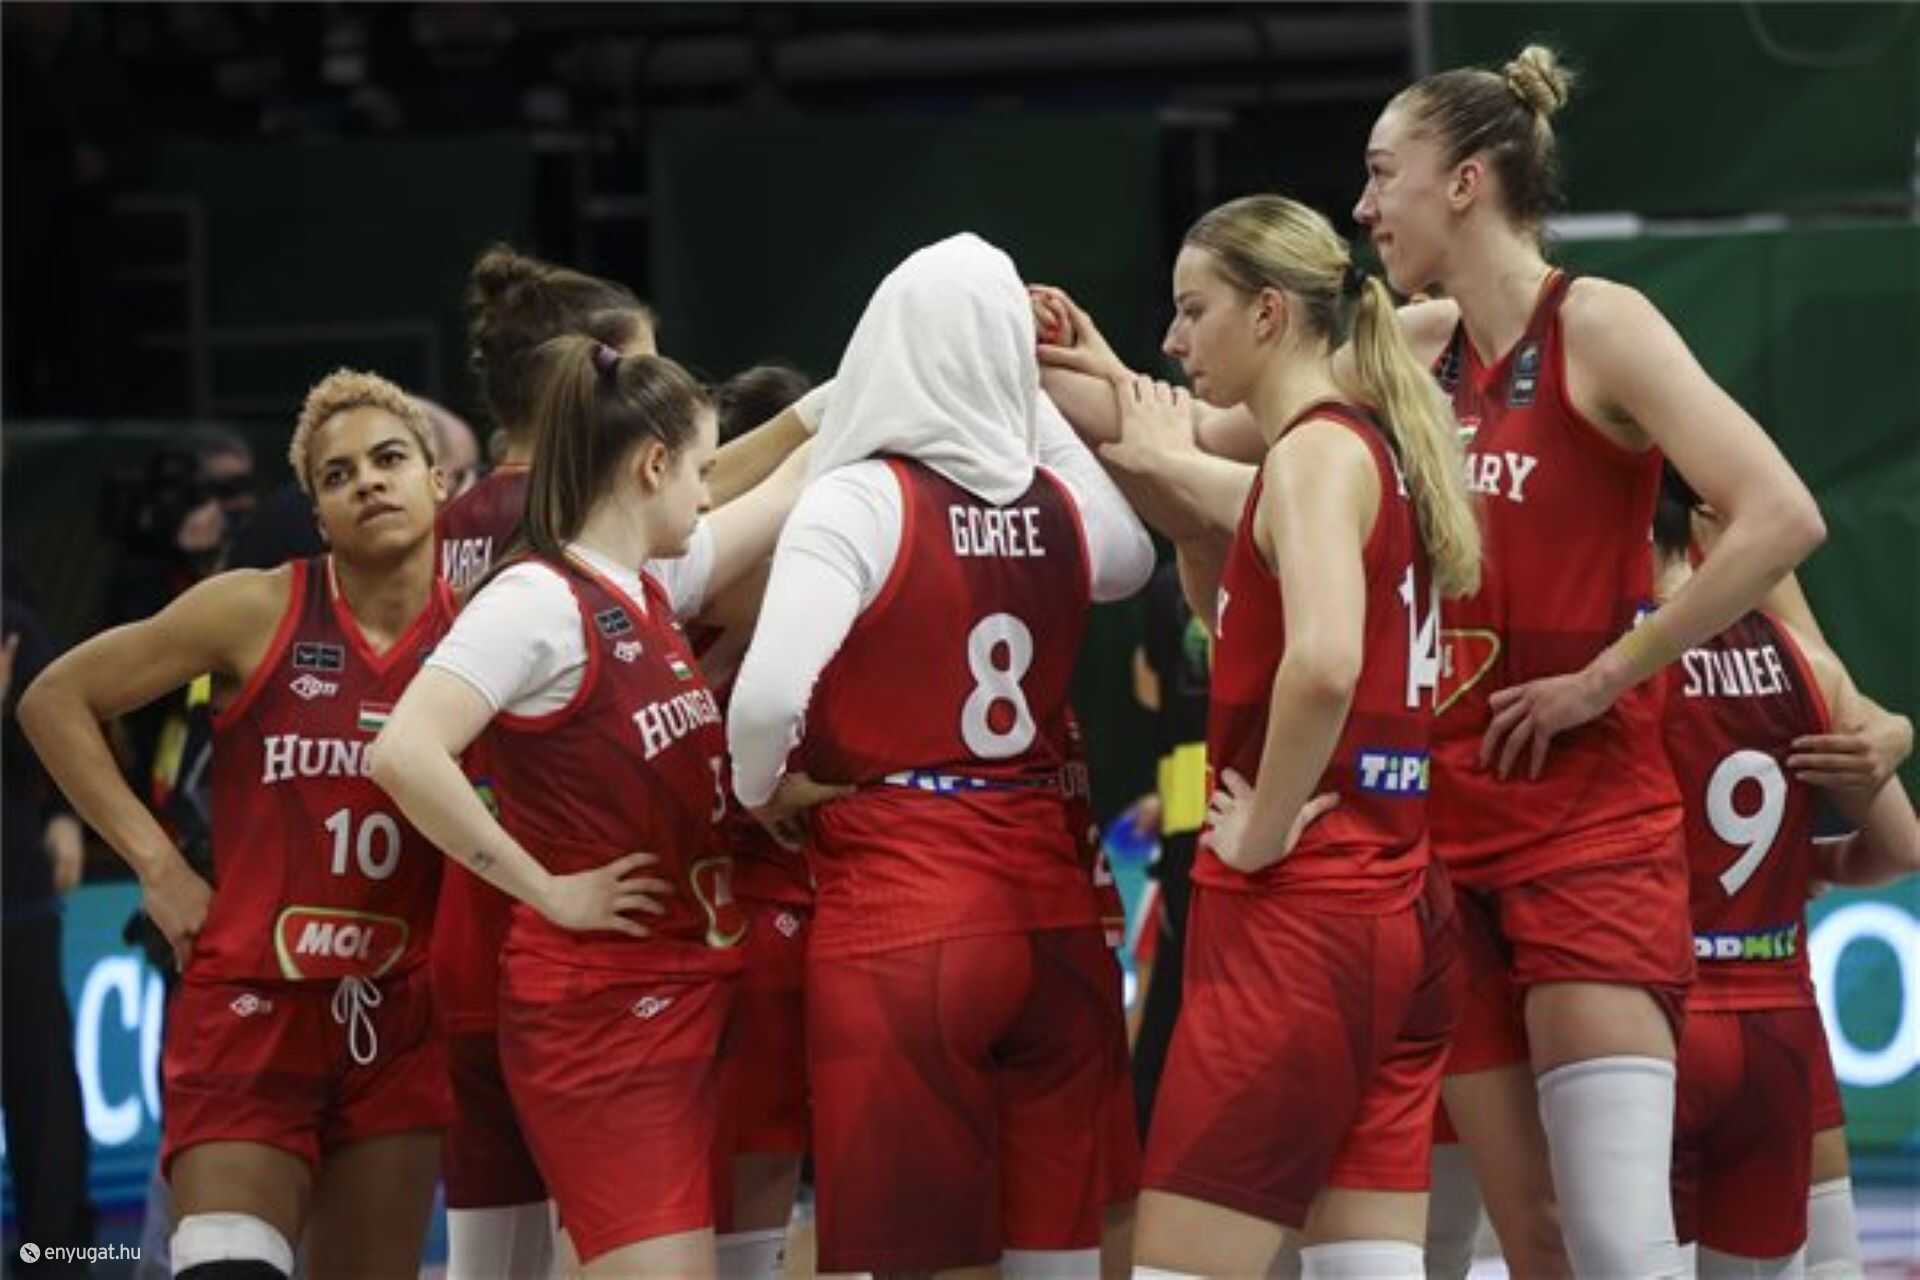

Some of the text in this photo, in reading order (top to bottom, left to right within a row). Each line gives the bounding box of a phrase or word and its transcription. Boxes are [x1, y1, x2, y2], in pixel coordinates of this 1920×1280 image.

[961, 612, 1037, 759] 8
[324, 808, 400, 881] 10
[1706, 749, 1789, 897] 9
